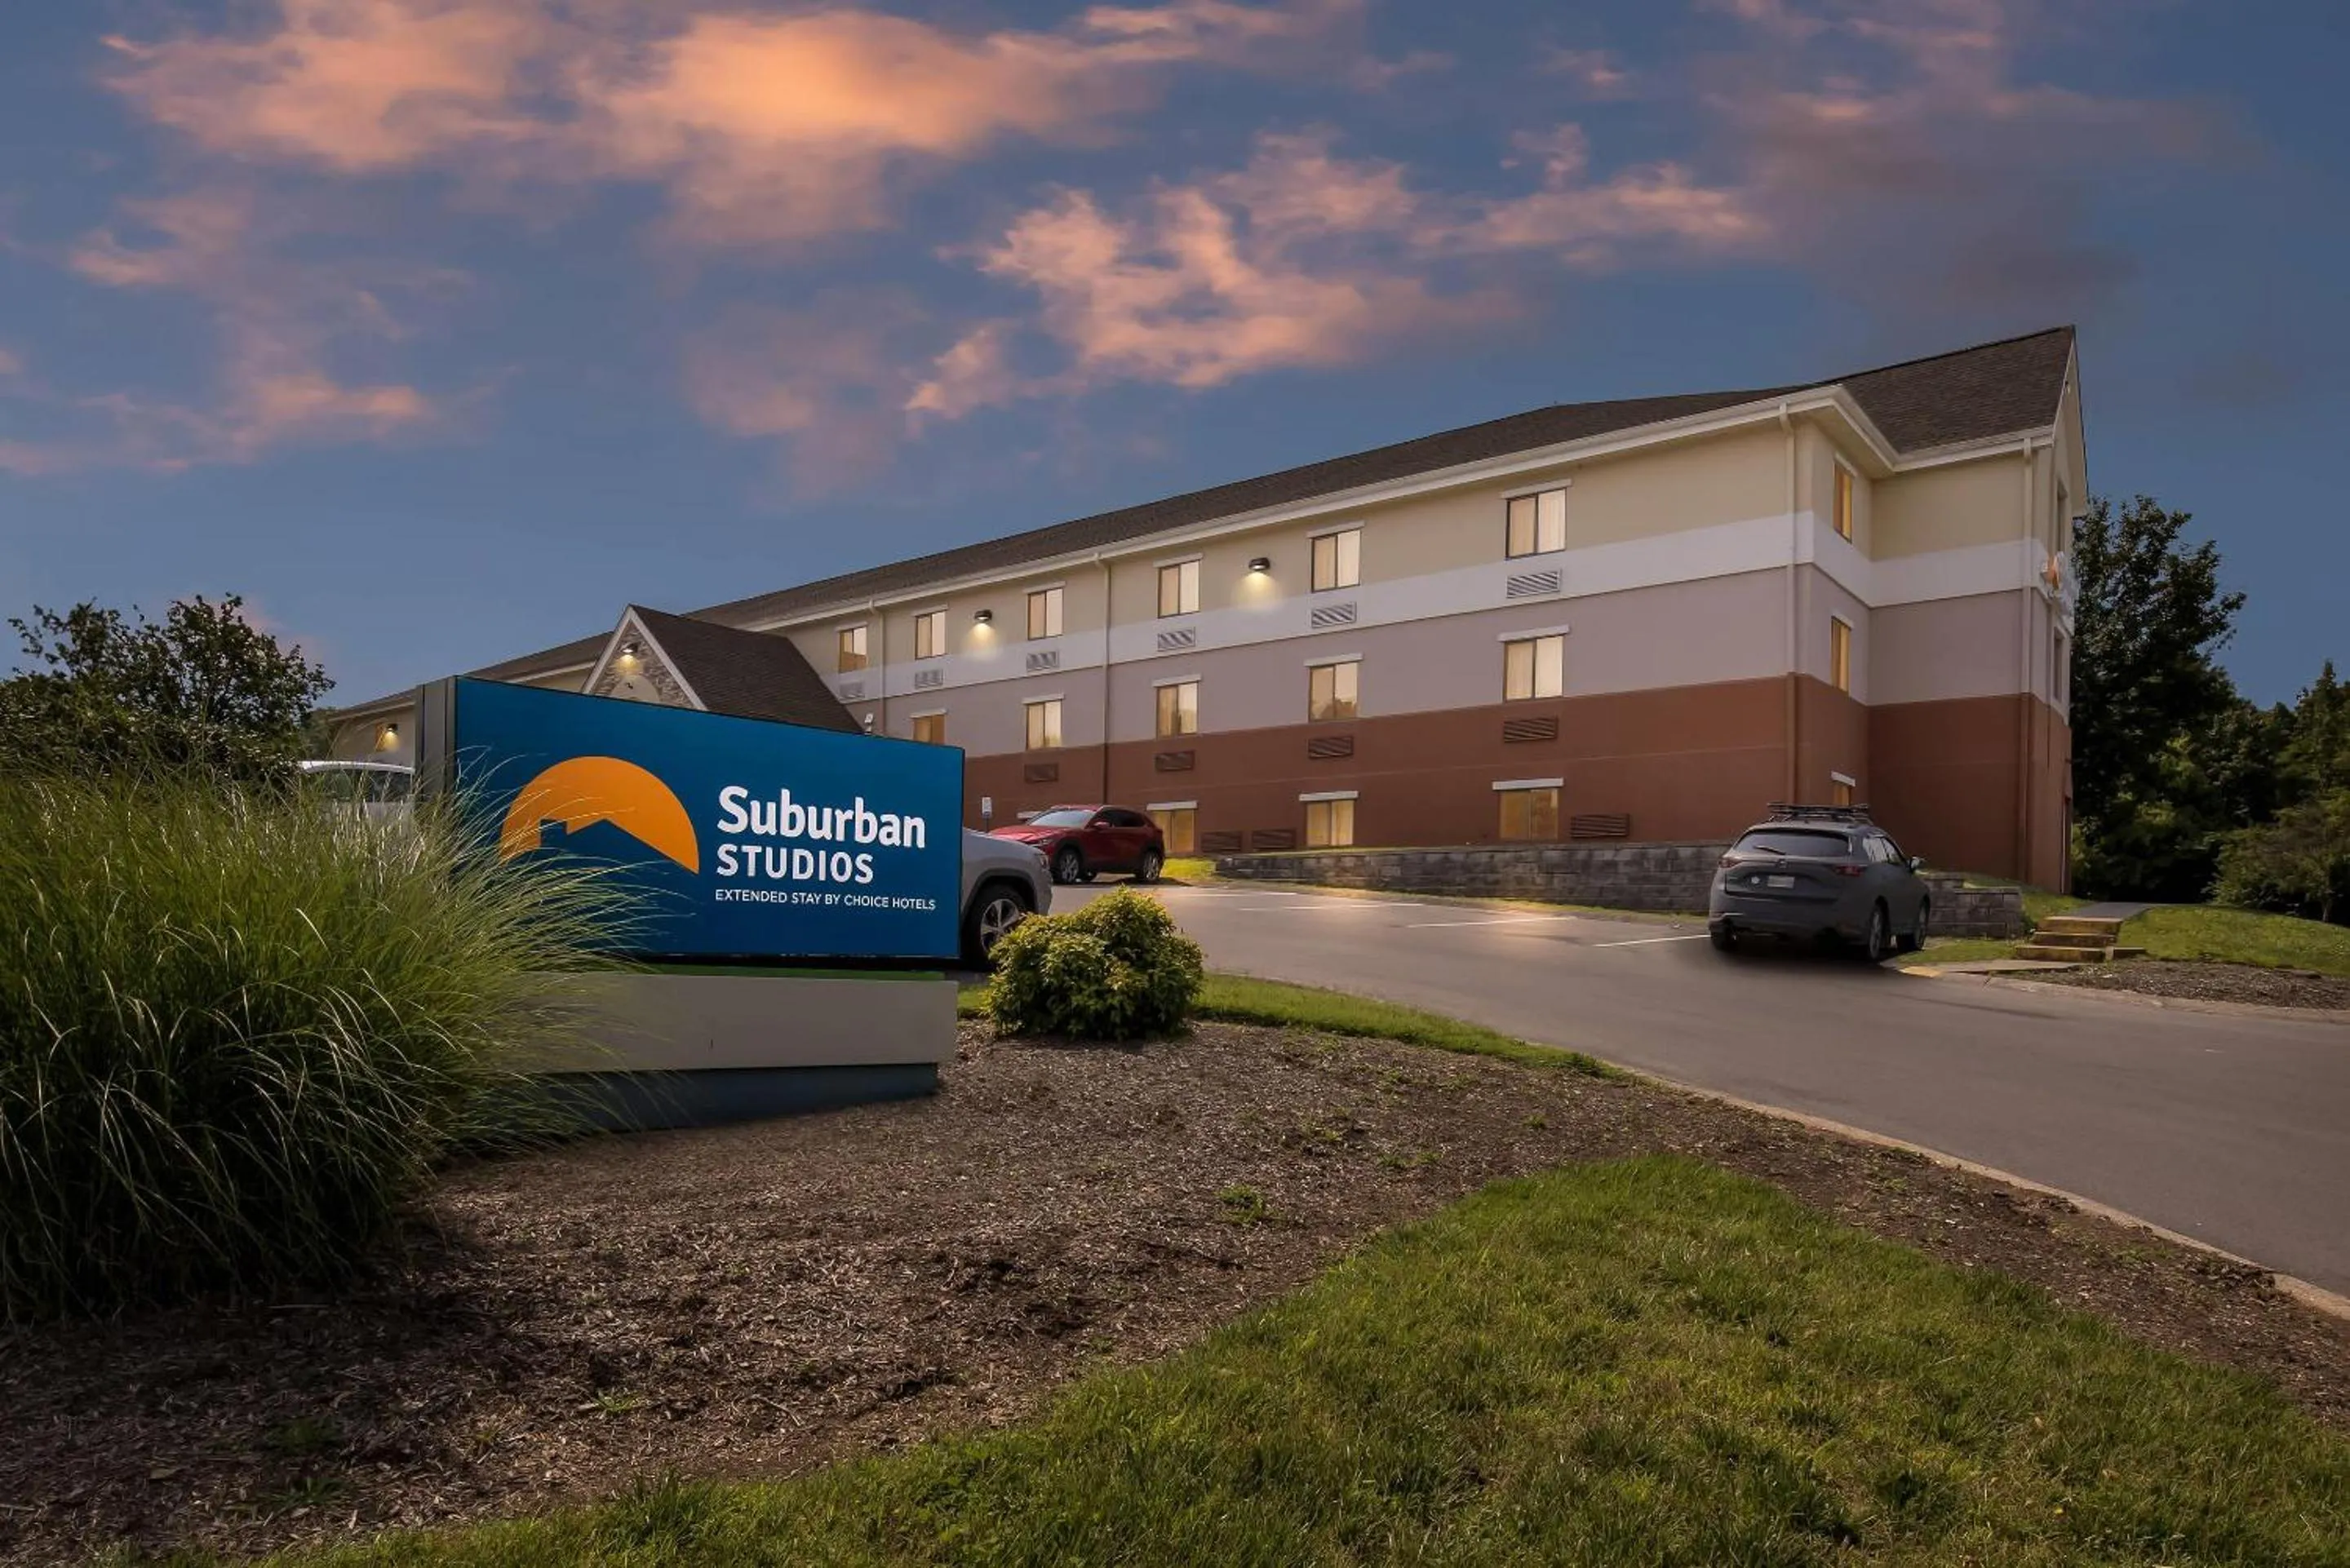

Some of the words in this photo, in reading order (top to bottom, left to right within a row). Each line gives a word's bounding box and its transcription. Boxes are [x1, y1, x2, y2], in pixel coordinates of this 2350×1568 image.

[716, 786, 925, 848] Suburban
[716, 844, 874, 884] STUDIOS
[715, 888, 787, 904] EXTENDED
[791, 892, 822, 905] STAY
[824, 893, 840, 906] BY
[844, 894, 889, 908] CHOICE
[892, 897, 936, 910] HOTELS
